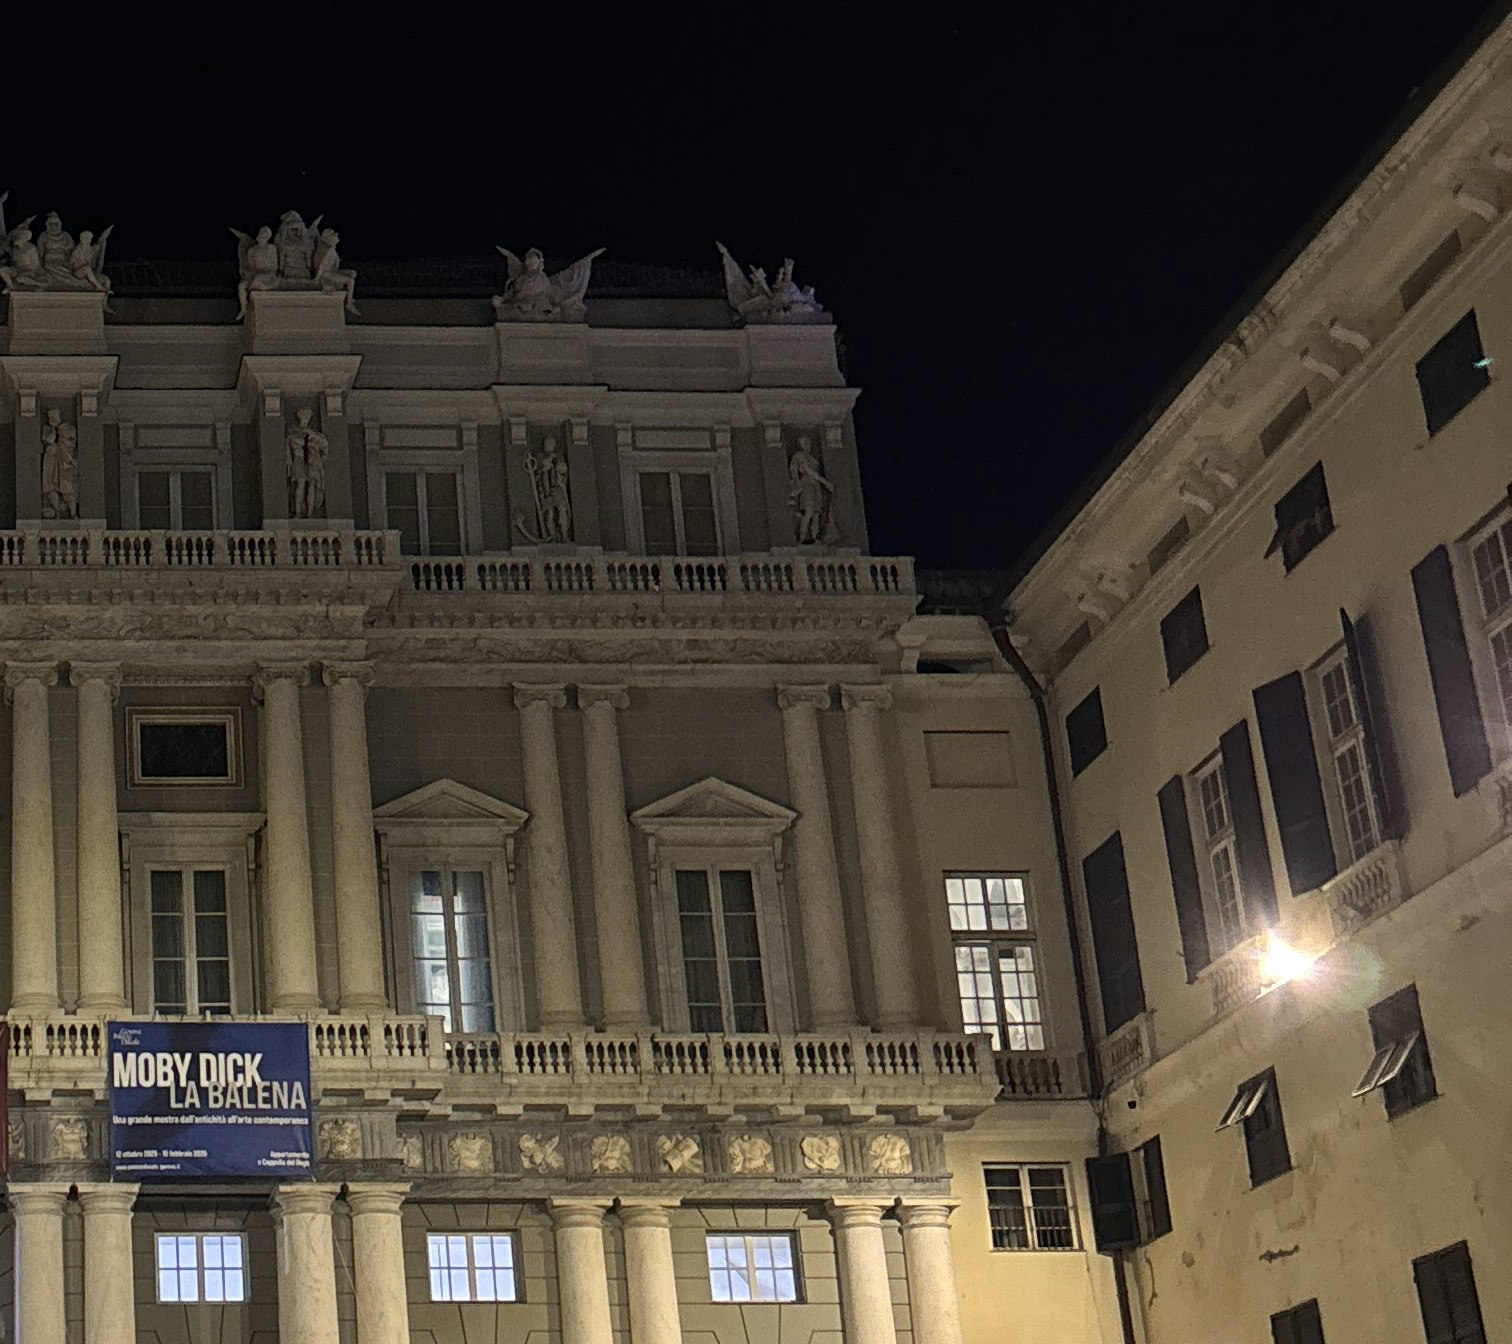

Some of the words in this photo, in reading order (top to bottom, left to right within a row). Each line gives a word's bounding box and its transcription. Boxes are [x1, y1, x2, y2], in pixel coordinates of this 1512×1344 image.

[113, 1052, 192, 1088] MOBY
[199, 1052, 263, 1088] DICK
[169, 1080, 201, 1109] LA
[207, 1081, 307, 1110] BALENA
[127, 1115, 152, 1126] grande
[154, 1116, 179, 1124] mostra
[253, 1116, 309, 1126] contemporanea
